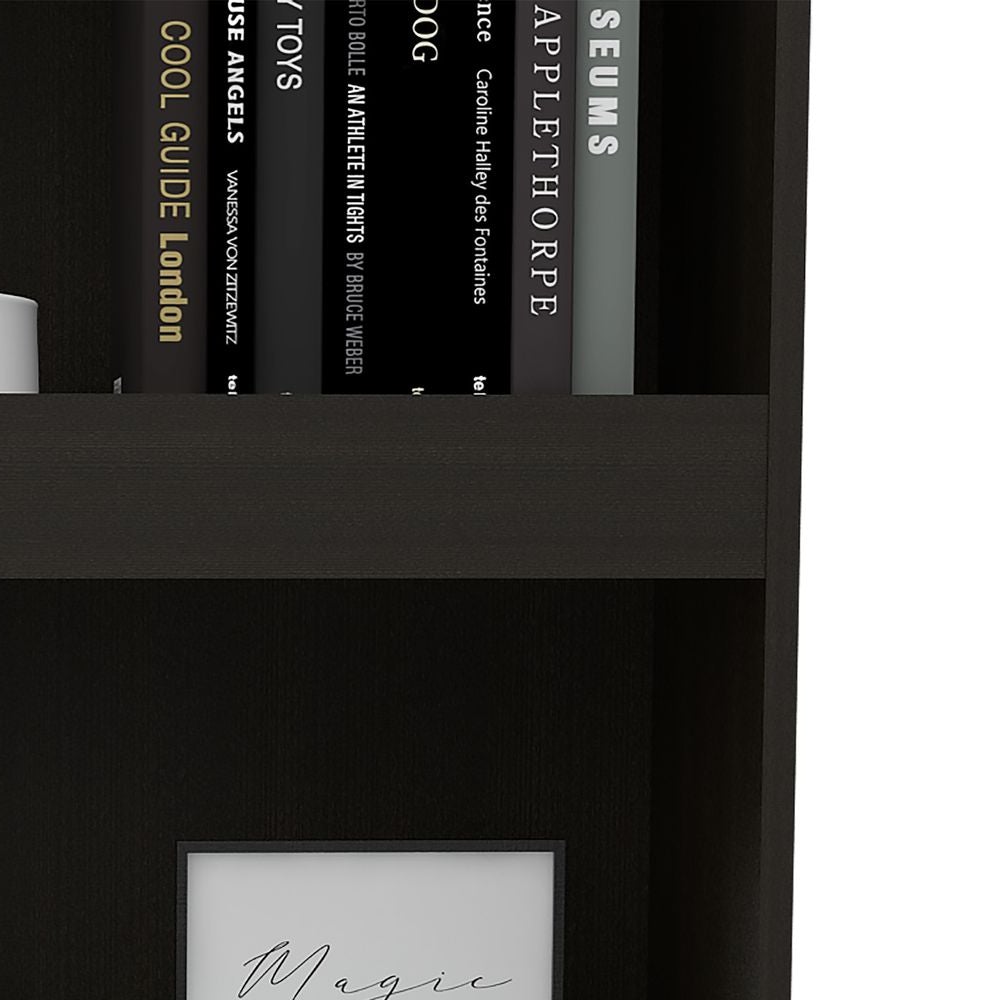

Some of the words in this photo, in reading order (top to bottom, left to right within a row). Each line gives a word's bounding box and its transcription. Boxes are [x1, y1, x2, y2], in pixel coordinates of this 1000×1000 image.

[476, 0, 492, 42] nce
[160, 20, 192, 109] COOL
[276, 18, 303, 90] TOYS
[347, 31, 366, 76] BOLLE
[587, 8, 621, 155] SEUMS
[227, 50, 245, 144] ANGELS
[347, 83, 366, 105] AN
[475, 68, 493, 136] Caroline
[159, 122, 191, 219] GUIDE
[346, 107, 366, 171] ATHLETE
[470, 140, 492, 190] Halley
[530, 4, 562, 316] APPLETHORPE
[226, 169, 239, 234] VANESSA
[346, 174, 365, 189] IN
[474, 194, 491, 223] des
[346, 192, 365, 244] TIGHTS
[225, 236, 238, 271] VON
[346, 252, 365, 271] BY
[473, 228, 491, 305] Fontaines
[159, 232, 189, 342] London
[225, 272, 238, 345] ZITZEWITZ
[345, 274, 364, 329] BRUCE
[345, 327, 364, 375] WEBER
